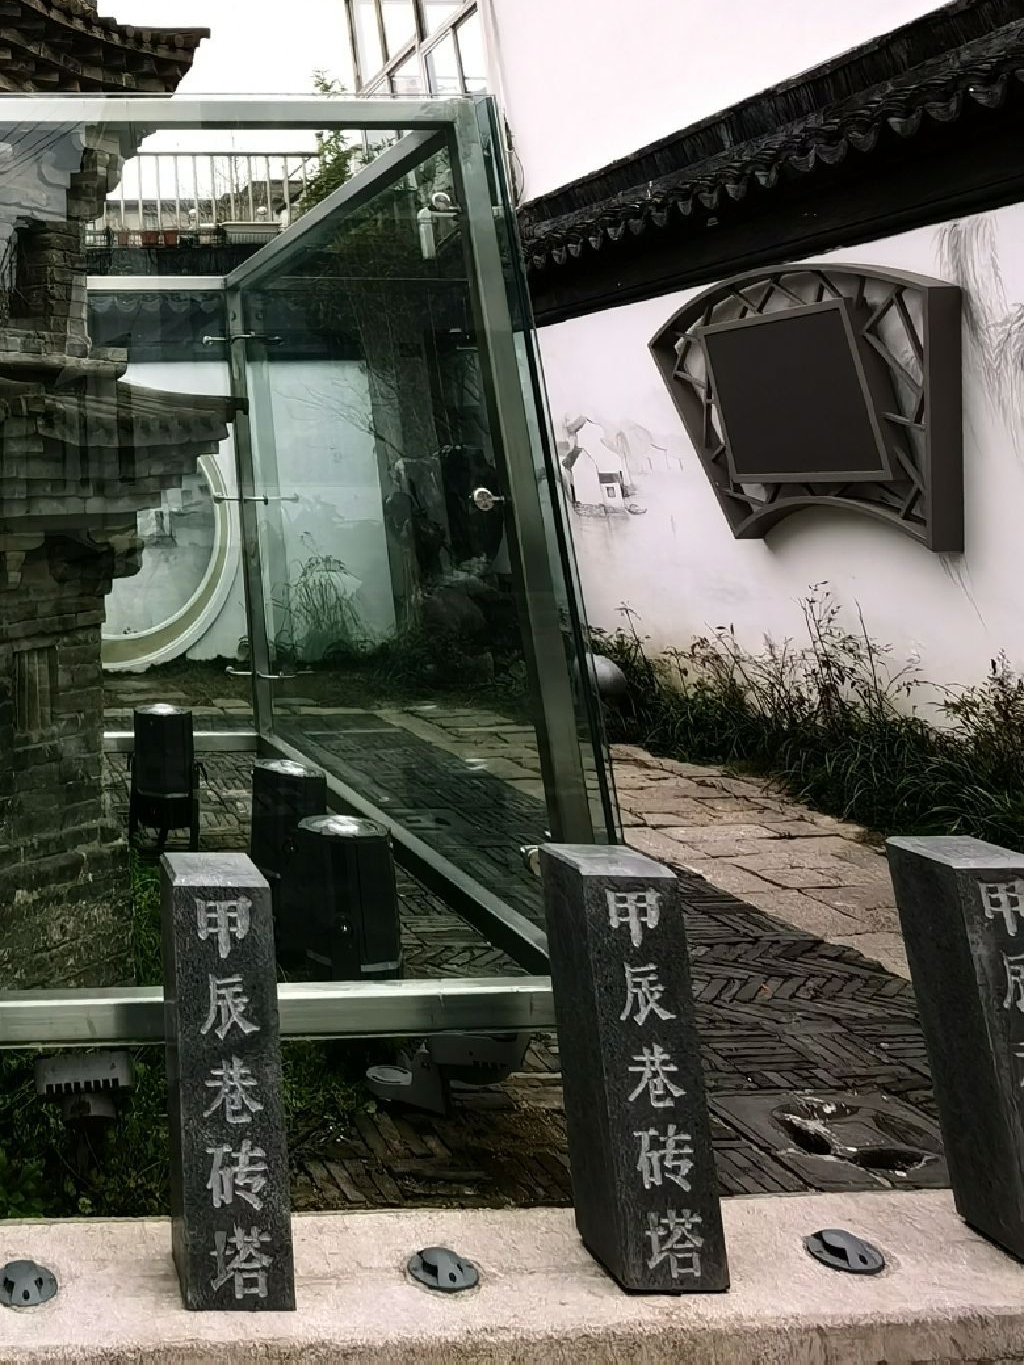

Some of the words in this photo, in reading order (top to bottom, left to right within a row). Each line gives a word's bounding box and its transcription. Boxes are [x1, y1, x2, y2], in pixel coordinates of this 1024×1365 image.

[196, 897, 274, 1300] 甲辰巷砖塔
[607, 888, 704, 1278] 甲辰巷砖塔
